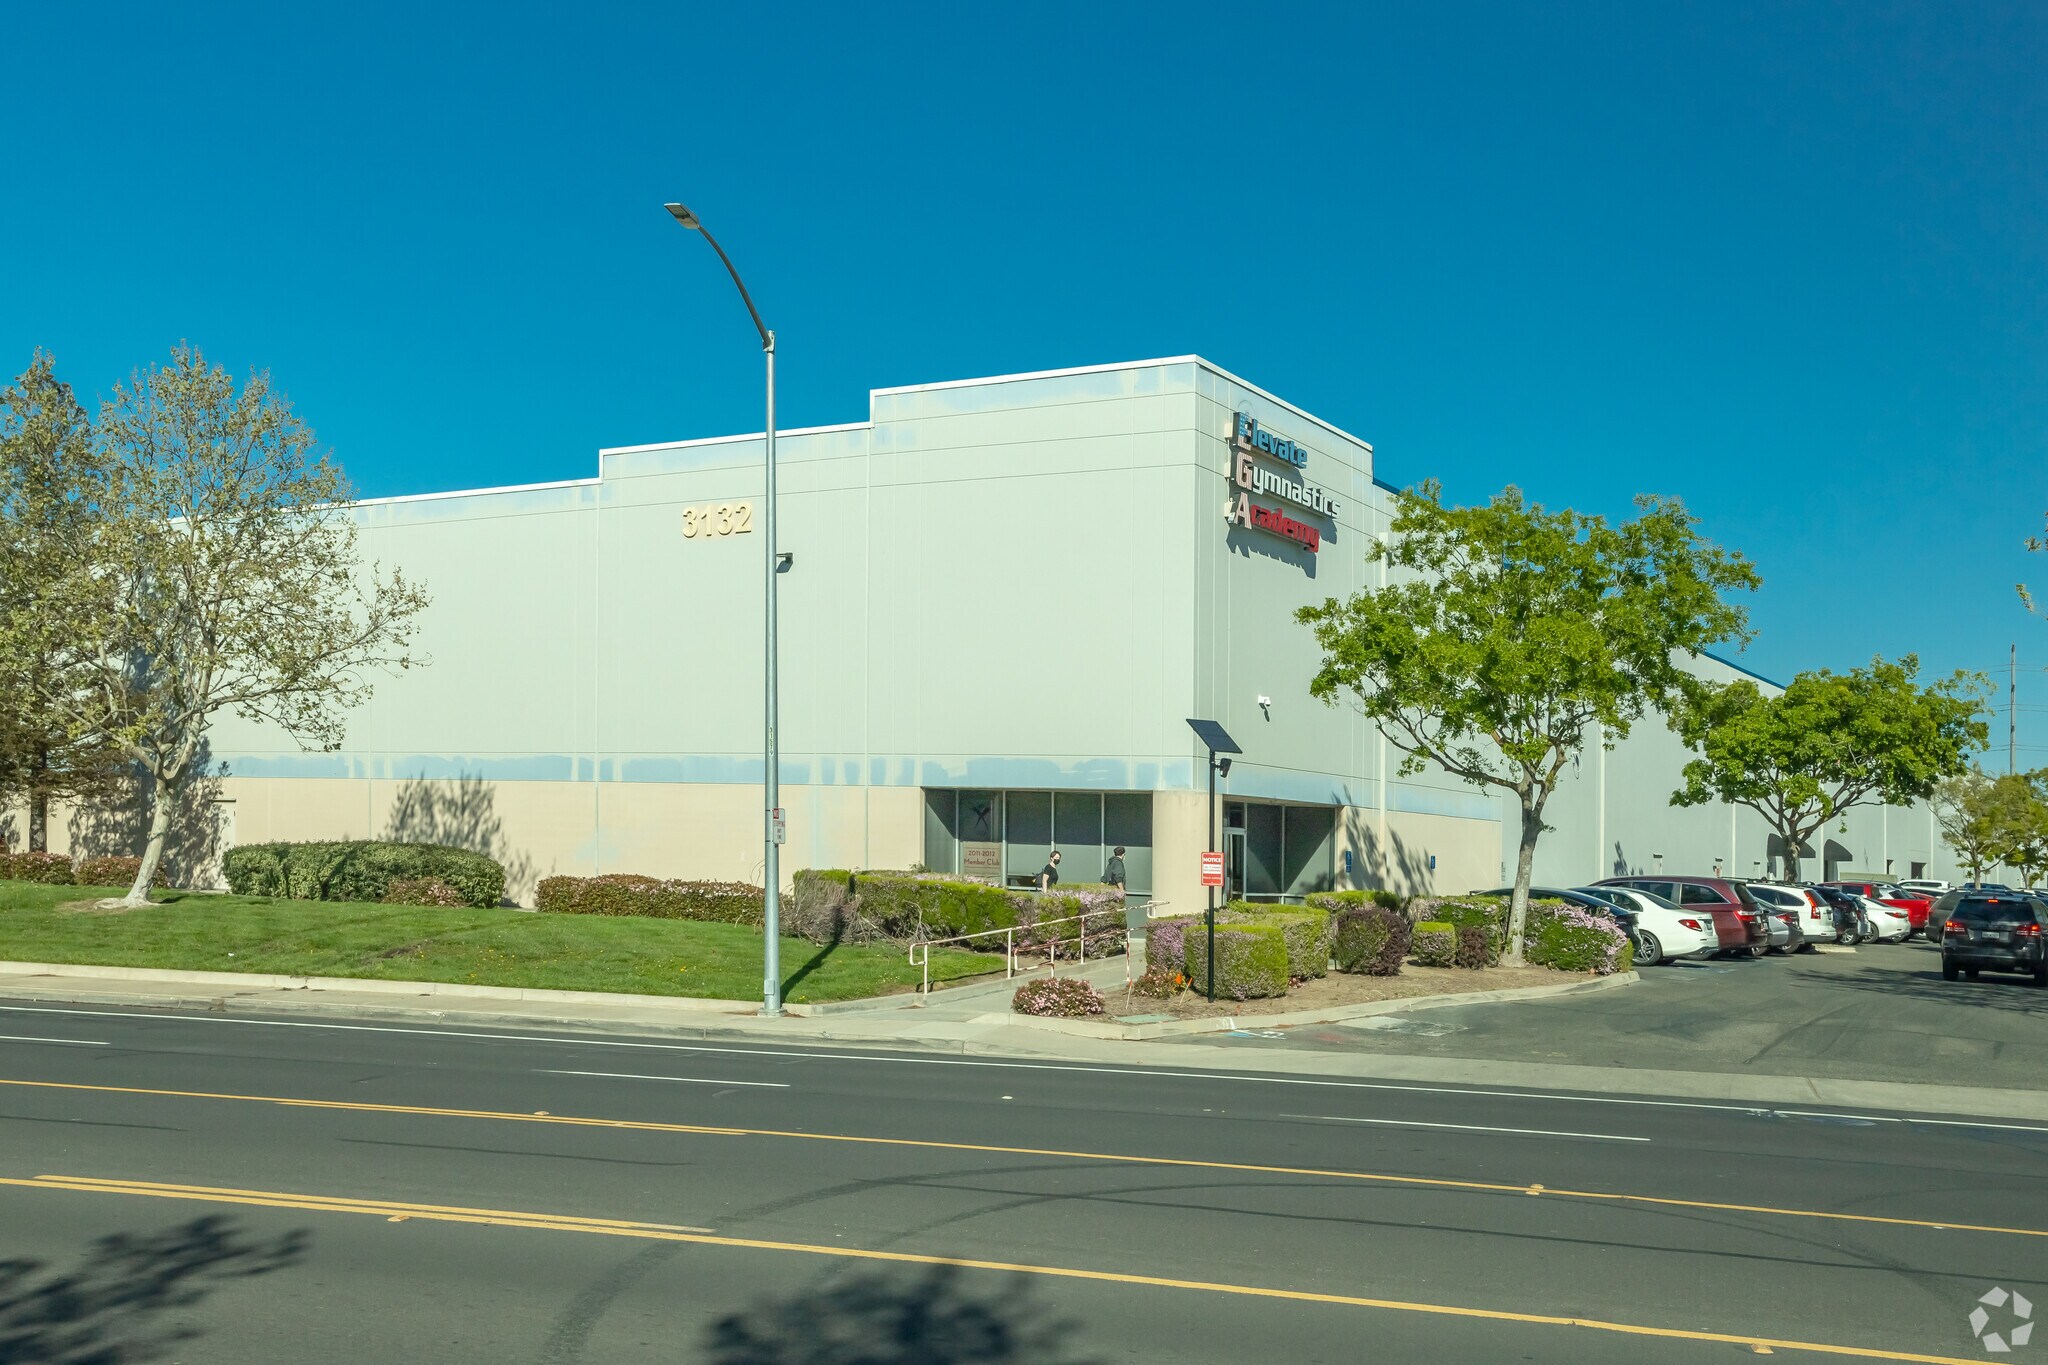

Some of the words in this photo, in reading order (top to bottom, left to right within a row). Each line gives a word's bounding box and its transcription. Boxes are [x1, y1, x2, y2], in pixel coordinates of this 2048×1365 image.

[1234, 412, 1307, 468] Elevate
[1235, 452, 1341, 518] Gymnastics
[682, 502, 752, 538] 3132
[1234, 492, 1319, 553] Academy
[987, 858, 1000, 866] Club
